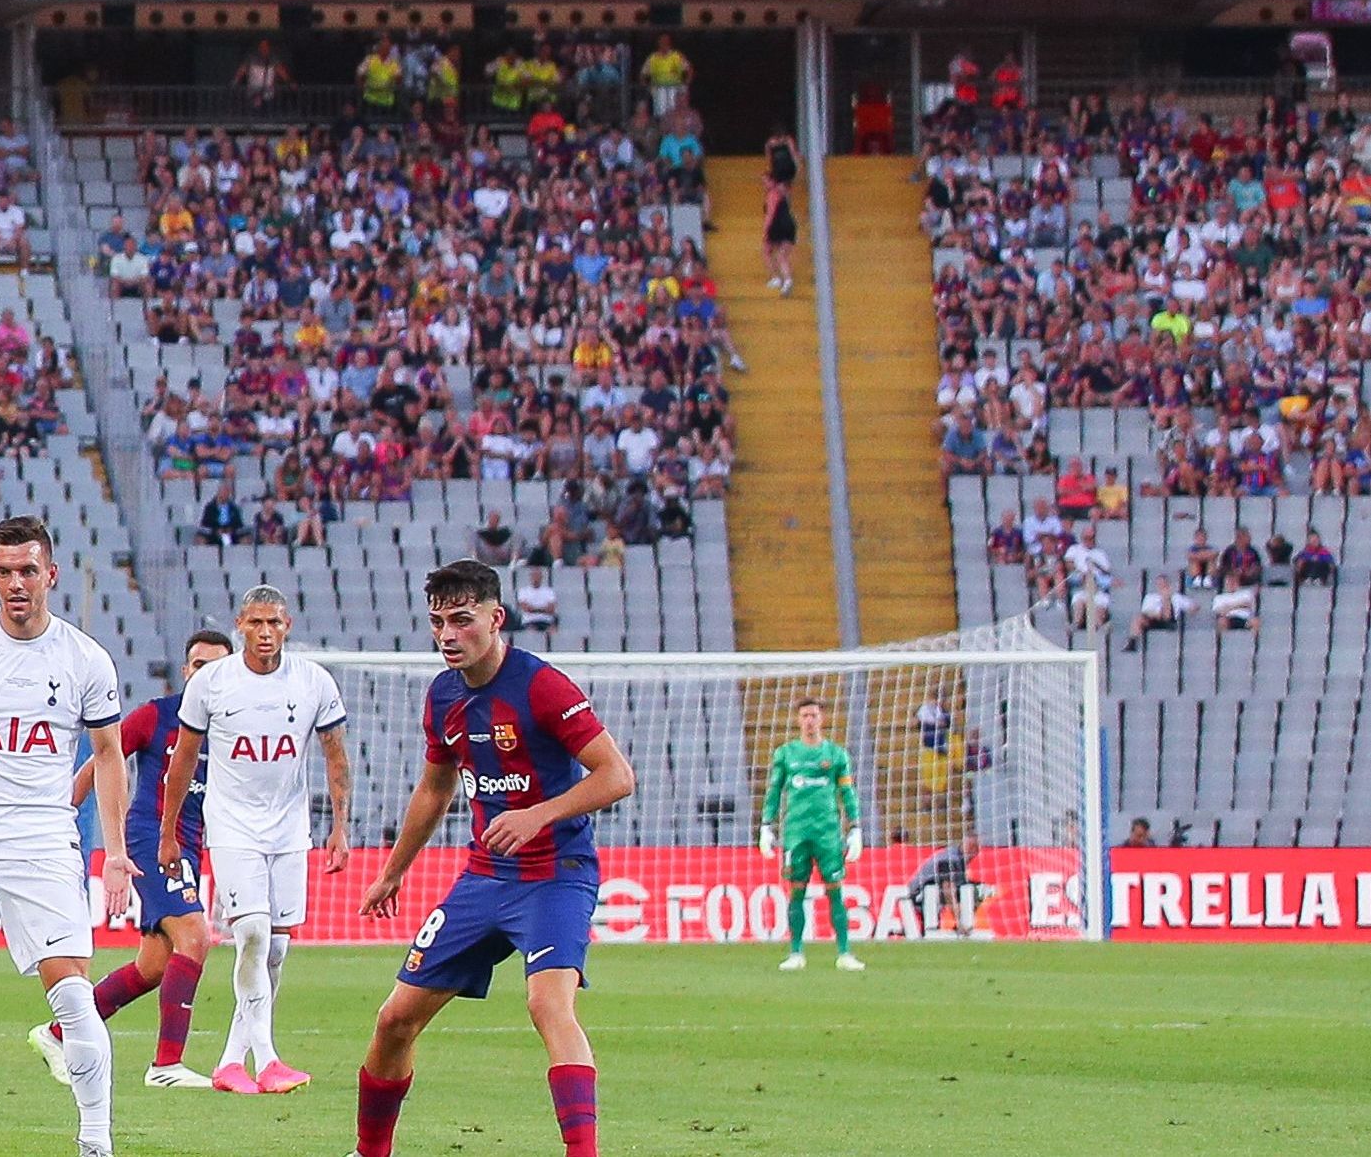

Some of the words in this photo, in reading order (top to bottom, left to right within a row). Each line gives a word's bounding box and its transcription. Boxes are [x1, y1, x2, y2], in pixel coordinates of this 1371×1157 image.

[230, 733, 298, 763] AIA
[478, 773, 531, 795] Spotify
[415, 908, 446, 949] 8
